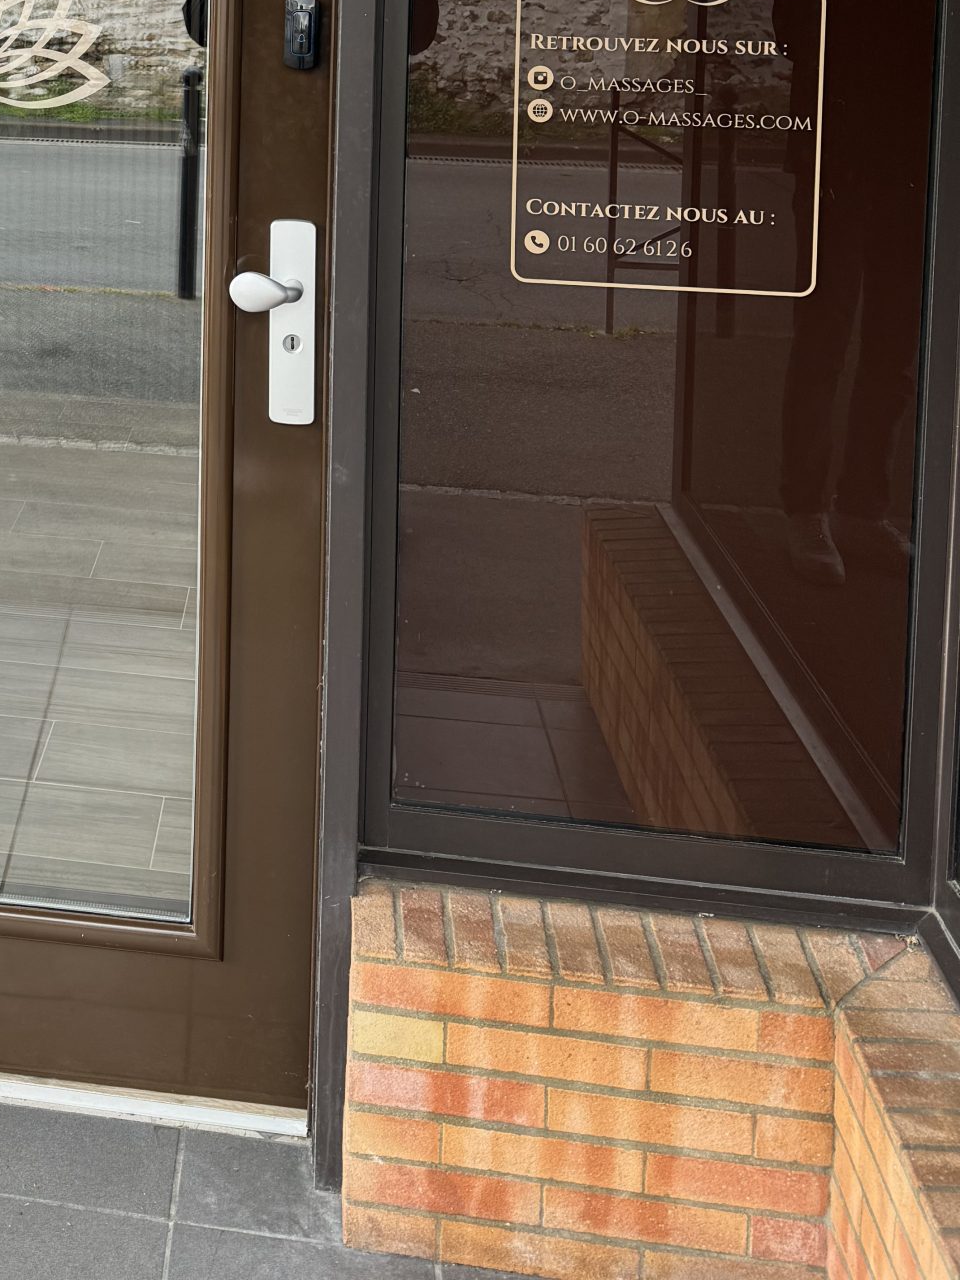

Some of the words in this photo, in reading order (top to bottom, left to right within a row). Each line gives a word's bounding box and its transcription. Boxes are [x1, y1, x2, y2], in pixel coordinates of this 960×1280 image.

[530, 33, 660, 54] RETROUVEZ
[666, 38, 728, 55] NOUS
[735, 40, 778, 56] SUR
[560, 108, 813, 131] WWW.O-MASSAGES.COM
[525, 198, 660, 221] CONTACTEZ
[666, 207, 728, 223] NOUS
[733, 210, 764, 225] AU
[557, 235, 576, 252] 01
[583, 236, 607, 254] 60
[613, 238, 637, 255] 62
